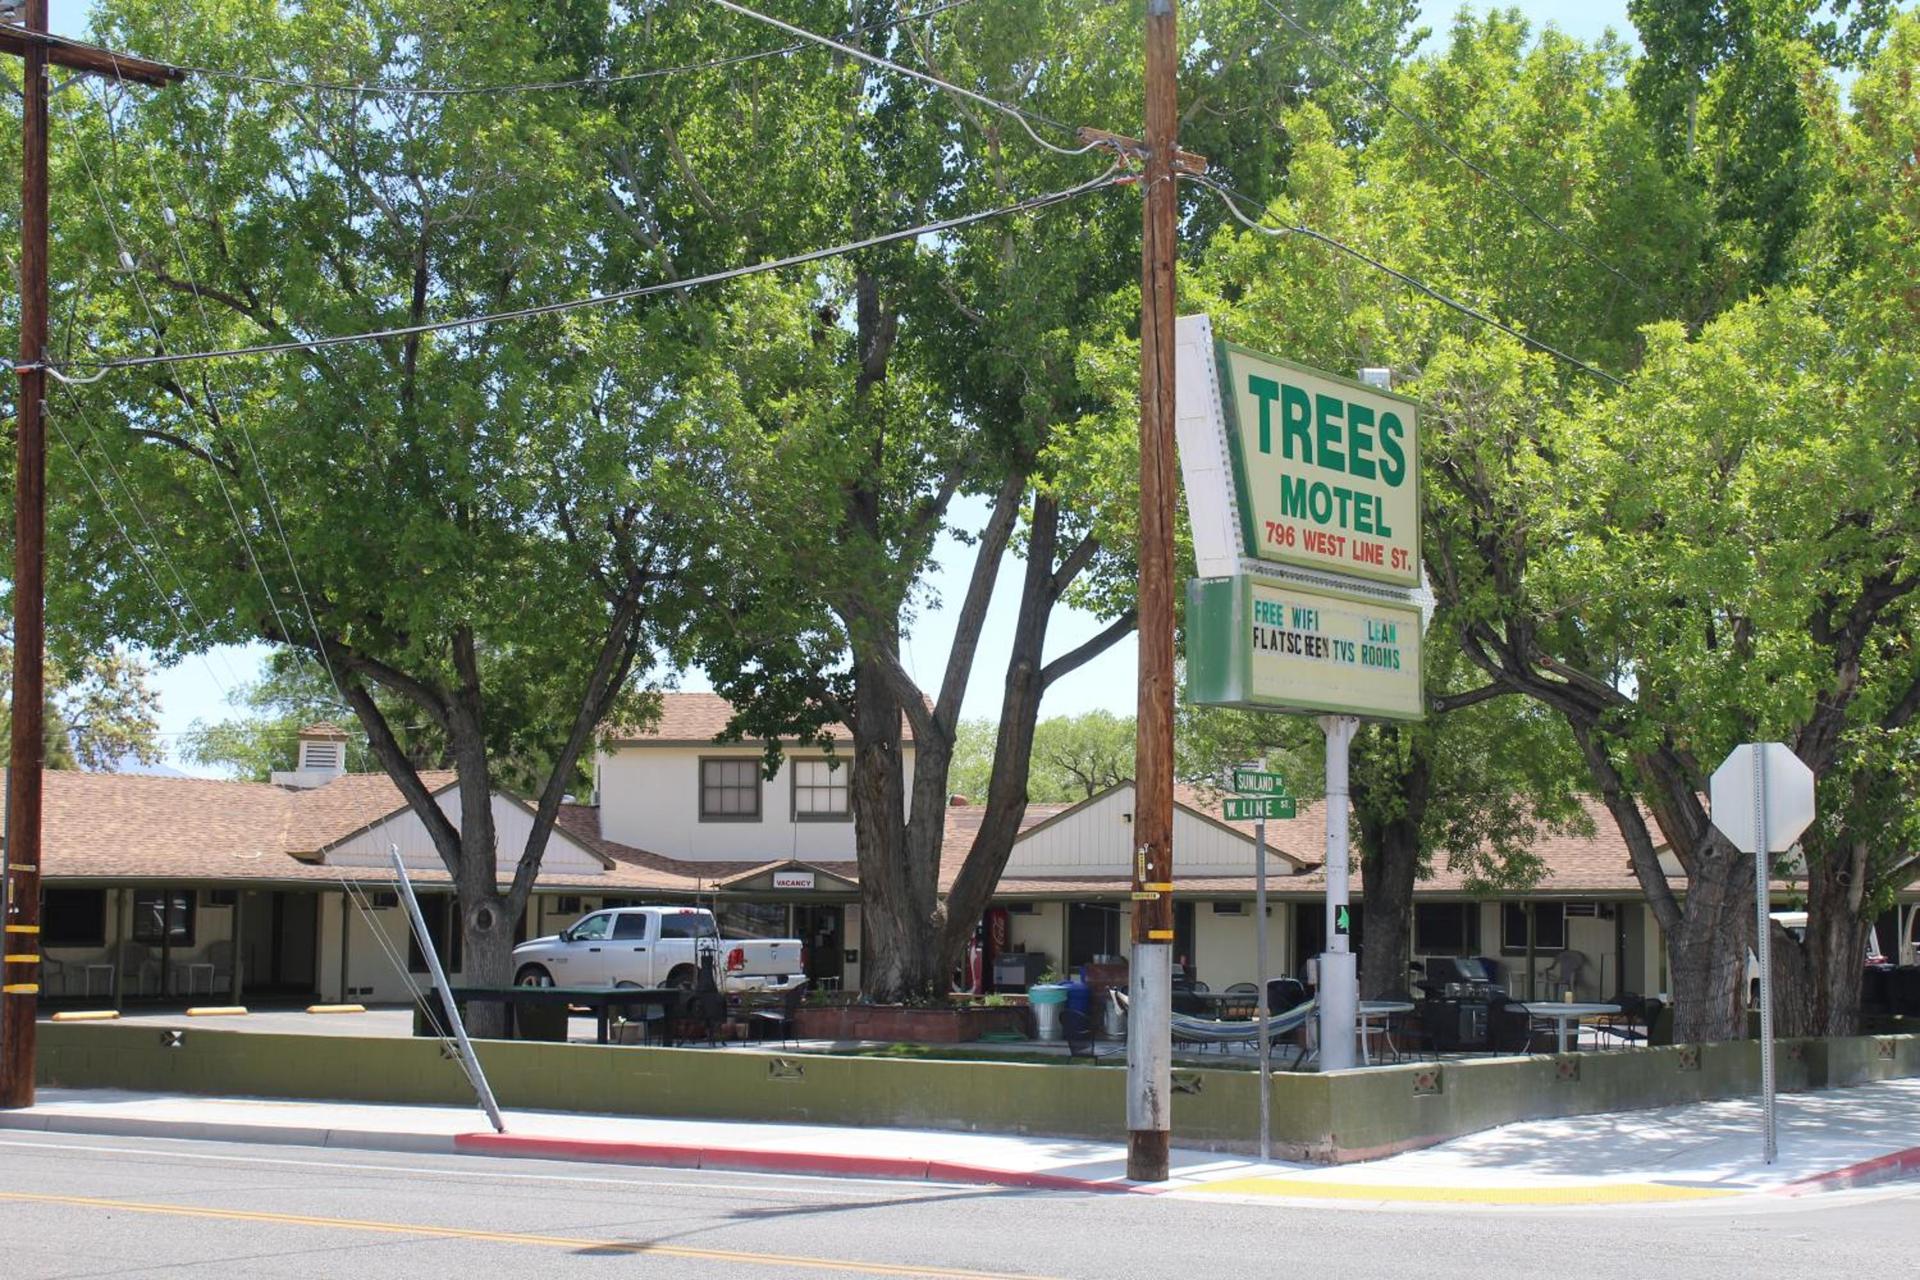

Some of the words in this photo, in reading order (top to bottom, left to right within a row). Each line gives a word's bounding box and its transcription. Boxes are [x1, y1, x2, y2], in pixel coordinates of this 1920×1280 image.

[1248, 374, 1406, 488] TREES
[1280, 474, 1392, 538] MOTEL
[1265, 521, 1295, 548] 796
[1303, 528, 1346, 557] WEST
[1352, 539, 1384, 565] LINE
[1391, 548, 1412, 572] ST.
[1254, 601, 1284, 626] FREE
[1292, 607, 1319, 631] WIFI
[1367, 620, 1397, 644] LEAN
[1333, 640, 1355, 663] TVS
[1361, 644, 1400, 669] ROOMS
[1238, 774, 1273, 791] SUNLAND
[1242, 800, 1273, 817] LINE
[776, 879, 812, 887] VACANCY
